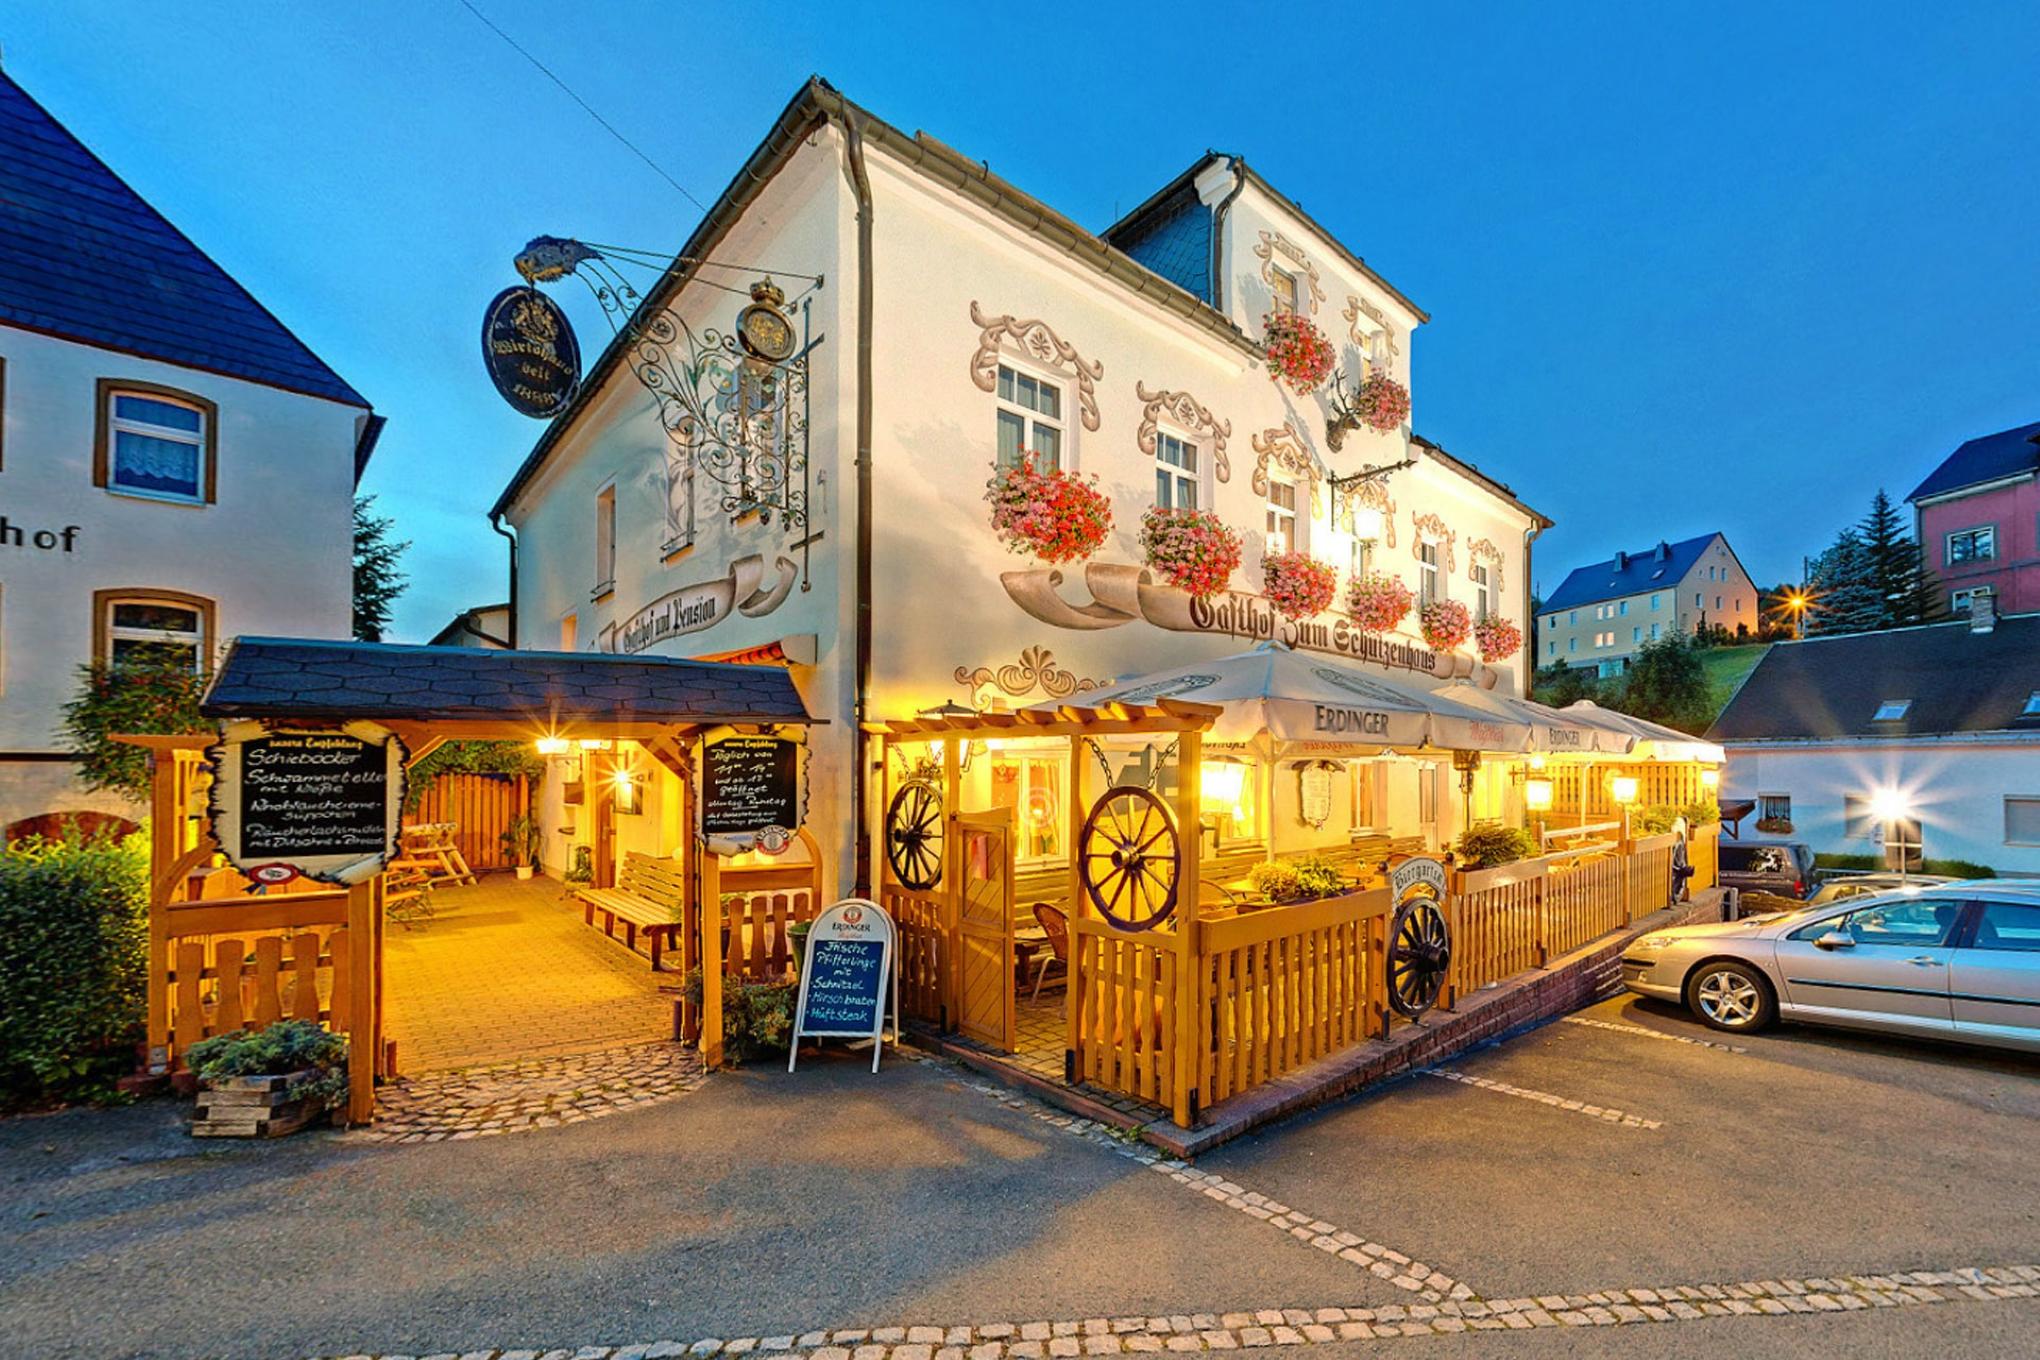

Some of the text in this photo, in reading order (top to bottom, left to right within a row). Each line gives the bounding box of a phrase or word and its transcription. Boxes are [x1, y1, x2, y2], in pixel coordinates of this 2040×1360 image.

[655, 603, 671, 636] und
[673, 596, 716, 633] Pension
[1315, 705, 1389, 736] ERDINGER
[1548, 727, 1580, 746] ERDINGER
[832, 922, 871, 932] ERDINGER
